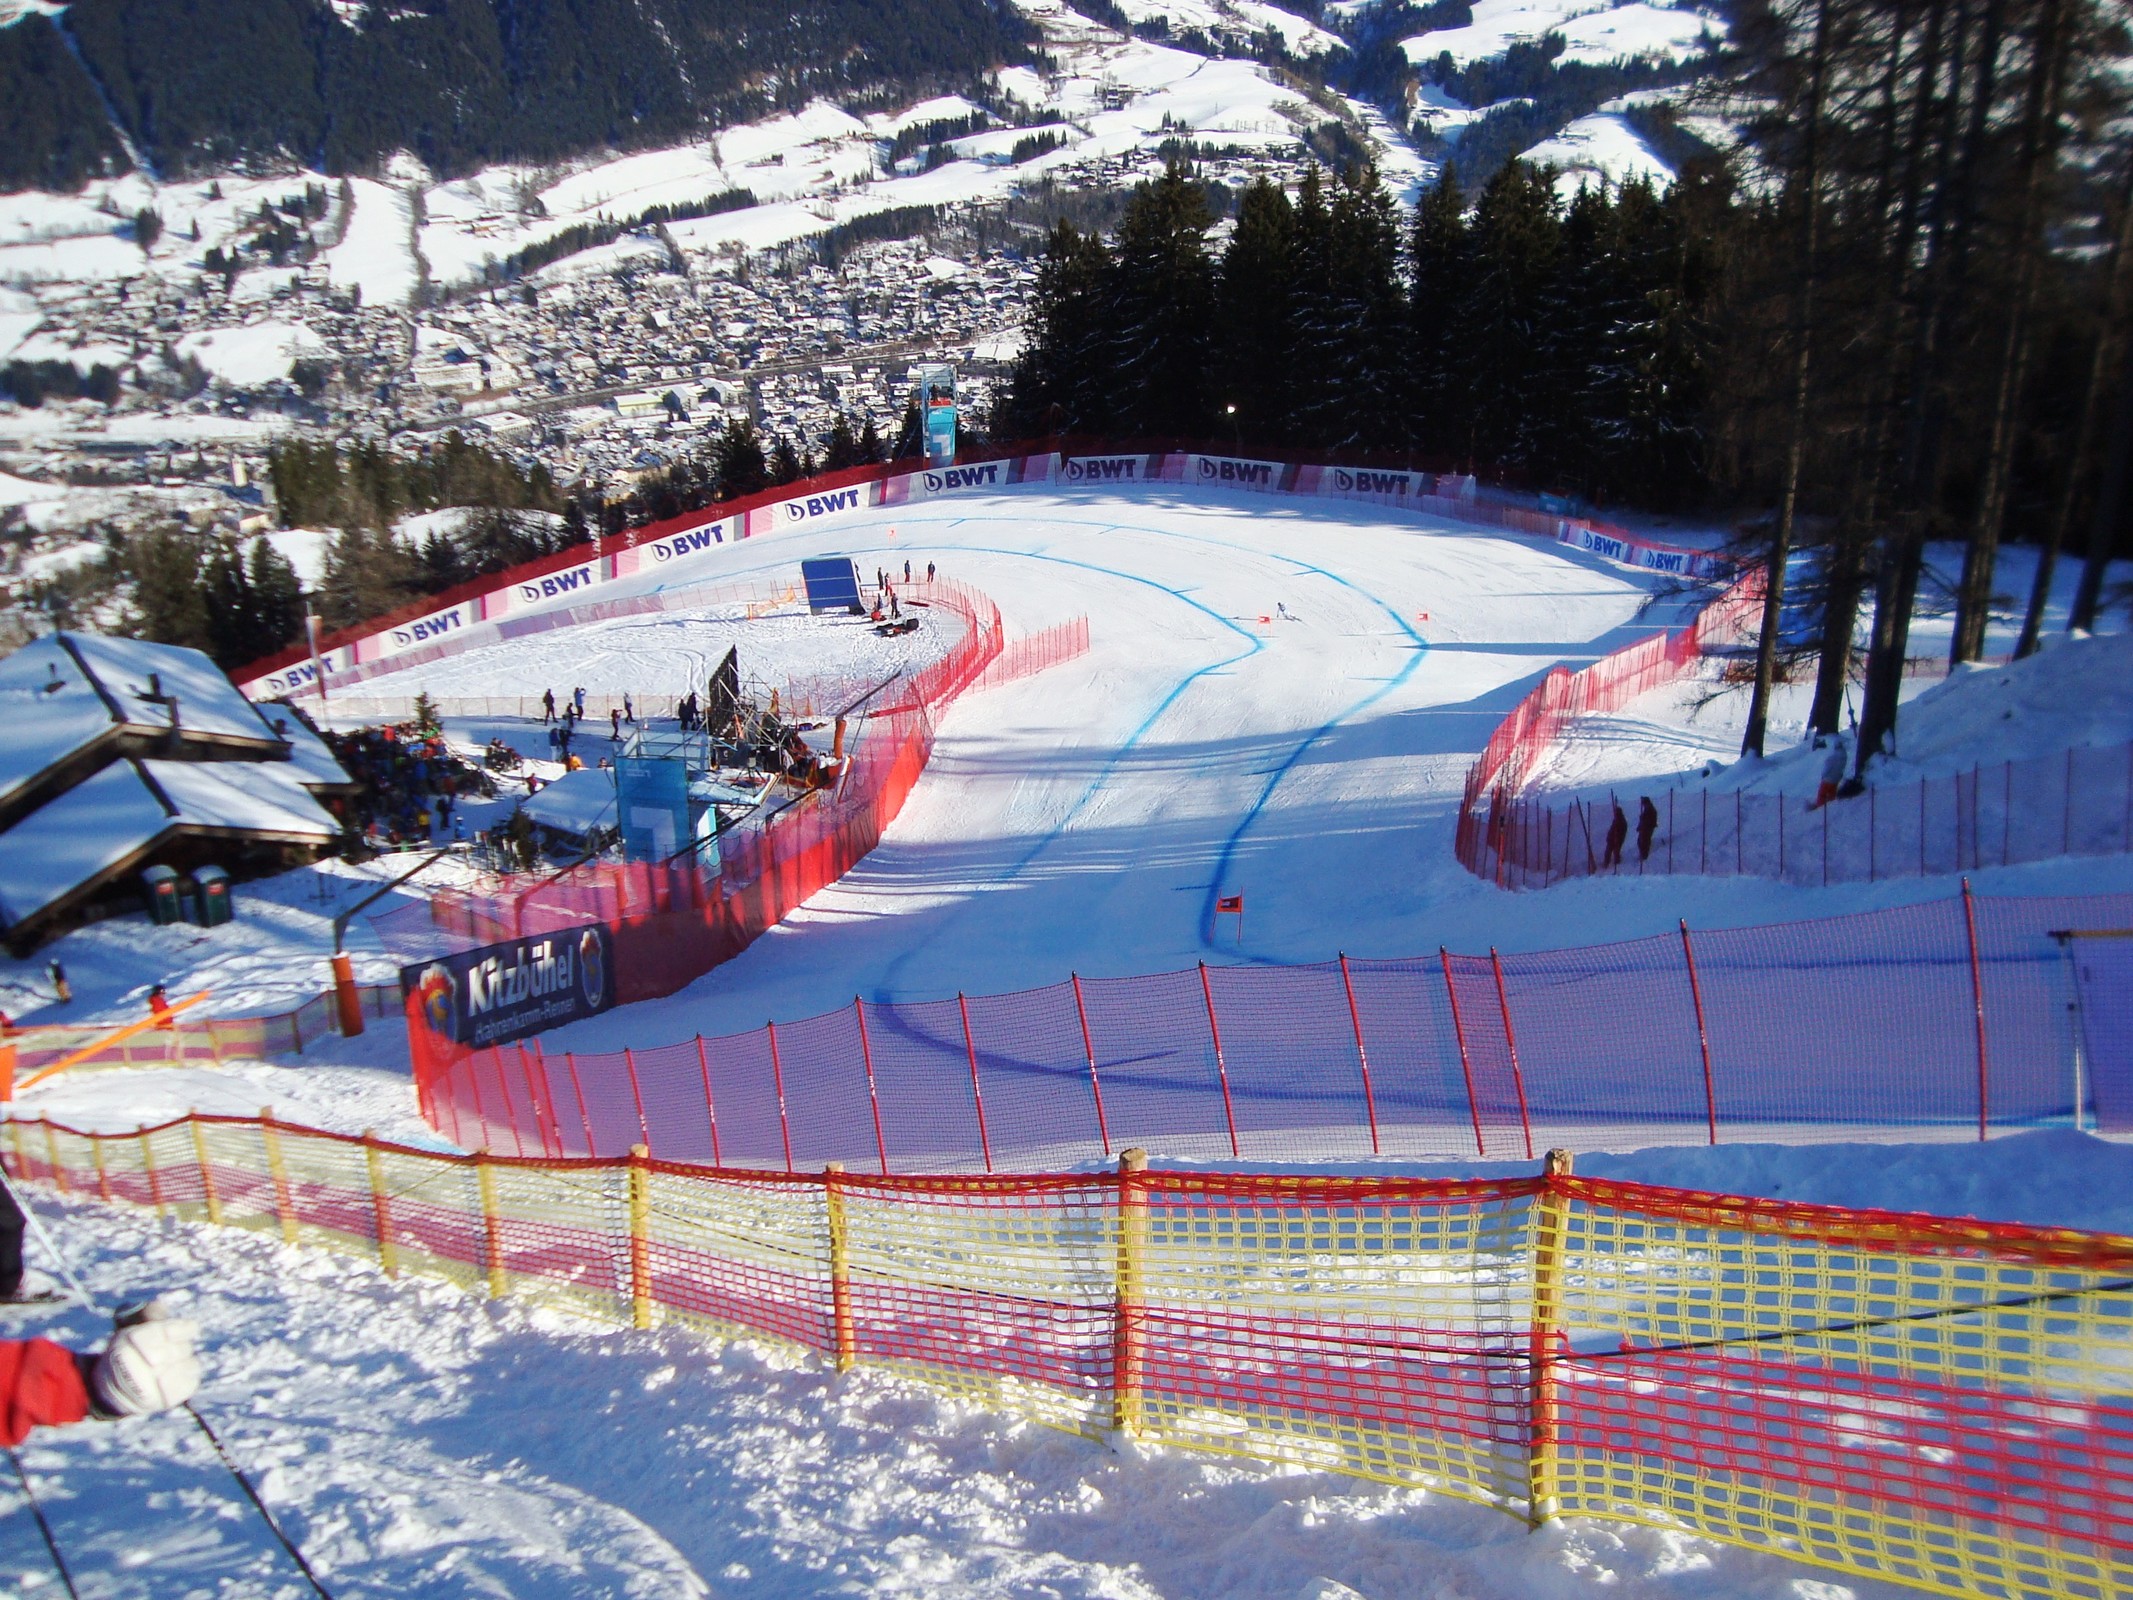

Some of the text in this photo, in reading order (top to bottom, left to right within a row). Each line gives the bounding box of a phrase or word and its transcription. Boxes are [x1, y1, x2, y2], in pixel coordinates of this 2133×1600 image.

[944, 464, 999, 489] BWT
[1086, 458, 1137, 480] BWT
[1220, 460, 1272, 485] BWT
[1356, 471, 1410, 495] BWT
[806, 489, 859, 517] BWT
[672, 524, 724, 556] BWT
[1594, 535, 1622, 559] BWT
[1655, 552, 1683, 572] BWT
[540, 567, 591, 598] BWT
[412, 610, 461, 641] BWT
[286, 657, 334, 688] BWT
[468, 940, 574, 1018] Kitzbühel
